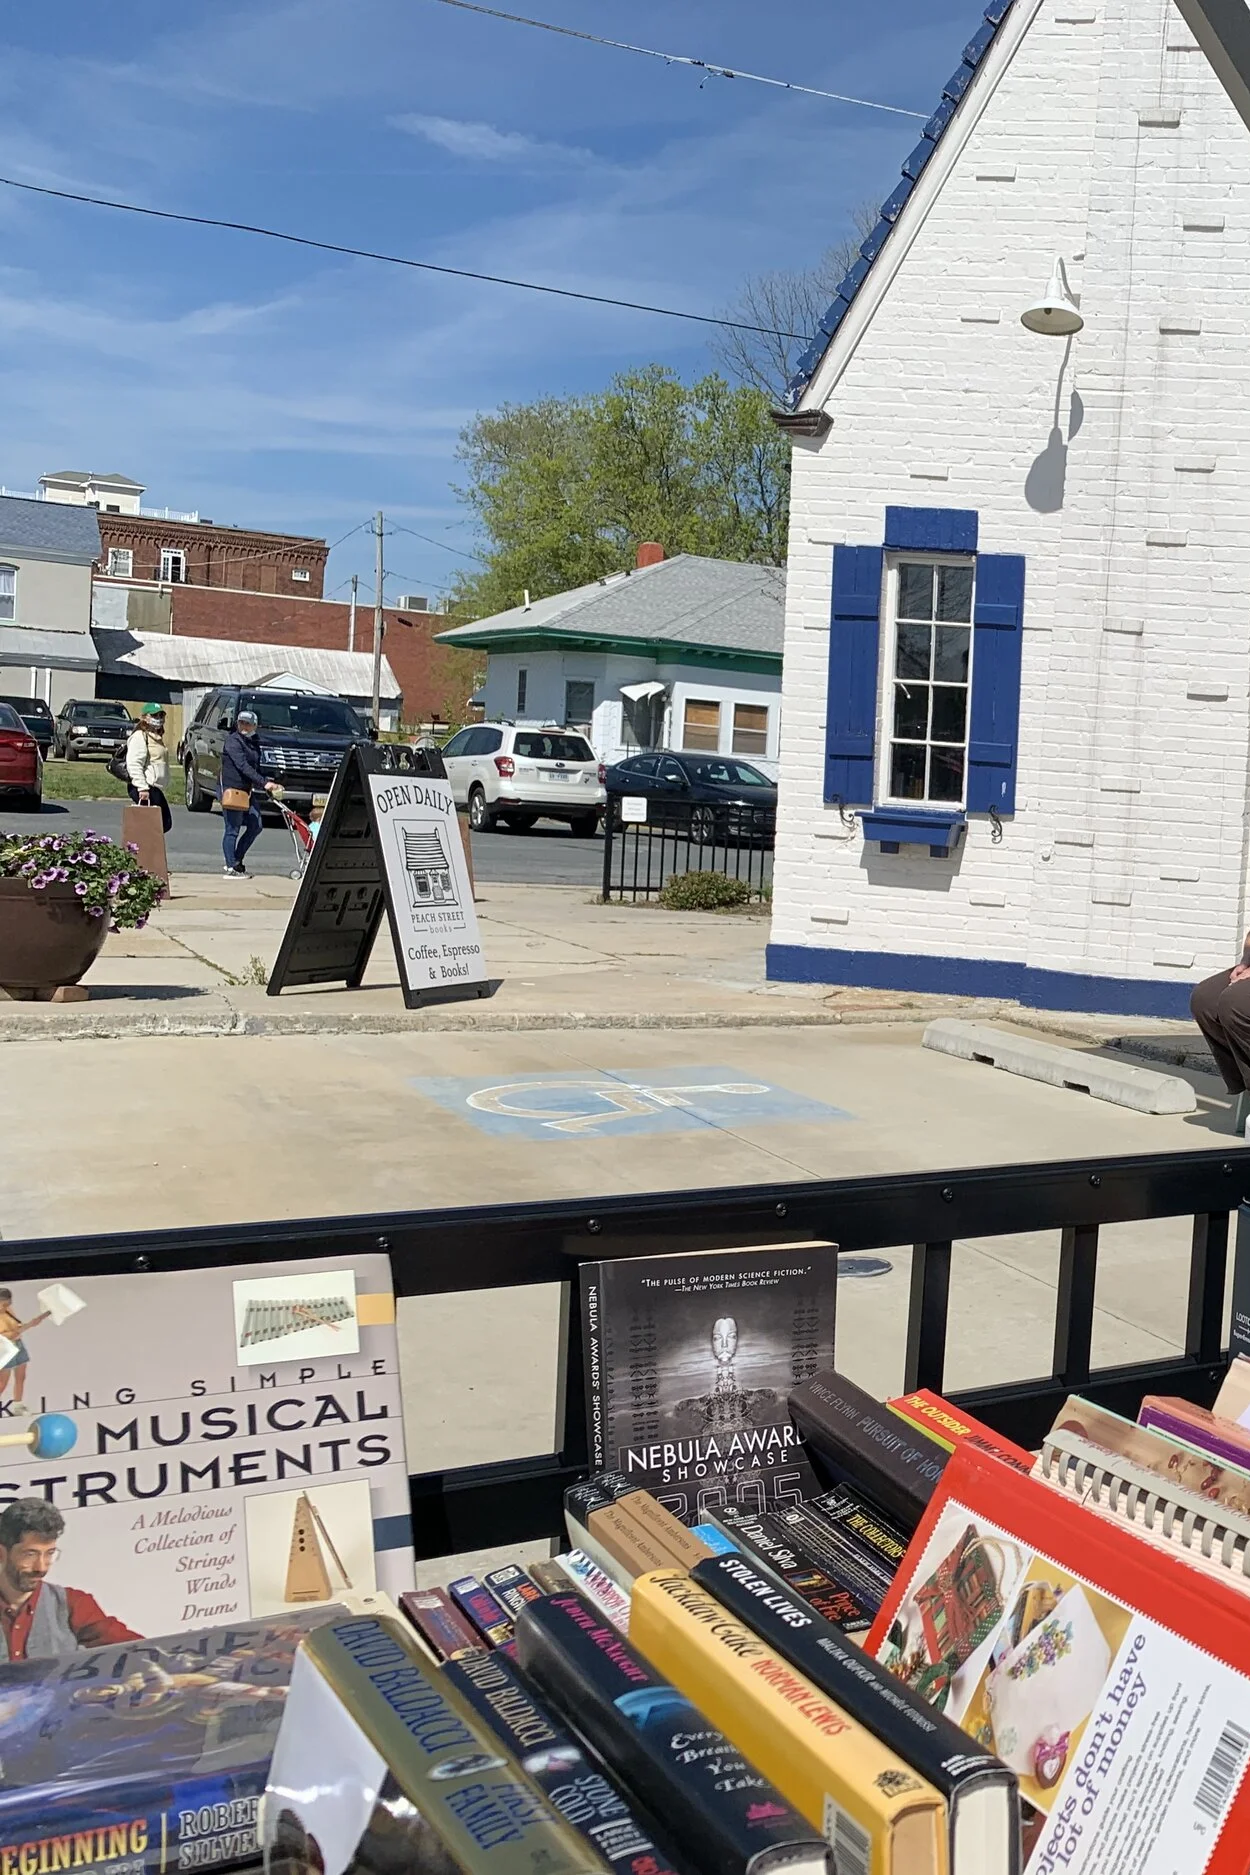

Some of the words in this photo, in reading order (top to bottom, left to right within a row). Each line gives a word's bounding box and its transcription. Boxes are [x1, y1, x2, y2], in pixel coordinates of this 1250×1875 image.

[376, 787, 413, 814] OPEN
[413, 785, 453, 815] DAILY
[411, 913, 436, 924] PEACH
[438, 911, 465, 922] STREET
[429, 924, 452, 934] books
[408, 945, 440, 960] Coffee,
[442, 944, 480, 960] Espresso
[429, 967, 437, 979] &
[441, 965, 469, 979] Books!
[664, 1278, 686, 1286] PULSE
[690, 1276, 699, 1284] OF
[703, 1274, 735, 1283] MODERN
[738, 1271, 770, 1279] SCIENCE
[709, 1282, 724, 1290] YORK
[725, 1281, 740, 1289] TIMES
[741, 1280, 758, 1288] BOOK
[759, 1278, 780, 1286] REVIEW
[588, 1286, 598, 1332] NEBULA
[191, 1359, 387, 1396] SIMPLE
[0, 1387, 136, 1417] KING
[97, 1390, 389, 1455] MUSICAL
[808, 1381, 830, 1405] VINCE
[831, 1396, 857, 1421] FLYNN
[856, 1416, 901, 1453] PURSUIT
[901, 1442, 919, 1464] OF
[904, 1395, 925, 1410] THE
[921, 1402, 971, 1436] OUTSIDER
[592, 1396, 603, 1466] SHOWCASE
[627, 1437, 722, 1473] NEBULA
[730, 1425, 804, 1456] AWAR
[0, 1434, 391, 1508] STRUMENTS
[662, 1449, 789, 1483] SHOWCASE
[131, 1514, 145, 1532] A
[150, 1504, 233, 1529] Melodious
[846, 1514, 868, 1529] THE
[859, 1524, 906, 1558] COLLECTORS
[134, 1533, 213, 1555] Collection
[220, 1524, 236, 1546] of
[740, 1523, 777, 1554] Daniel
[768, 1544, 798, 1570] Silva
[176, 1553, 235, 1574] Strings
[186, 1576, 237, 1596] Winds
[719, 1559, 773, 1598] STOLEN
[763, 1592, 814, 1628] LIVES
[180, 1601, 238, 1622] Drums
[332, 1620, 405, 1671] DAVID
[709, 1618, 763, 1658] Cake
[751, 1659, 807, 1709] NORMAN
[799, 1698, 851, 1736] LEWIS
[368, 1667, 476, 1753] BALDACCI
[457, 1652, 501, 1690] DAVID
[486, 1685, 556, 1747] BALDACCI
[1075, 1711, 1113, 1788] don't
[1107, 1634, 1146, 1705] have
[670, 1731, 724, 1749] Every
[706, 1757, 746, 1775] You
[1056, 1824, 1083, 1868] lot
[1081, 1781, 1099, 1816] of
[1096, 1672, 1146, 1778] money
[445, 1783, 530, 1849] FAMILY
[547, 1785, 595, 1824] COLD
[575, 1773, 632, 1819] STONE
[0, 1819, 147, 1875] EGINNING
